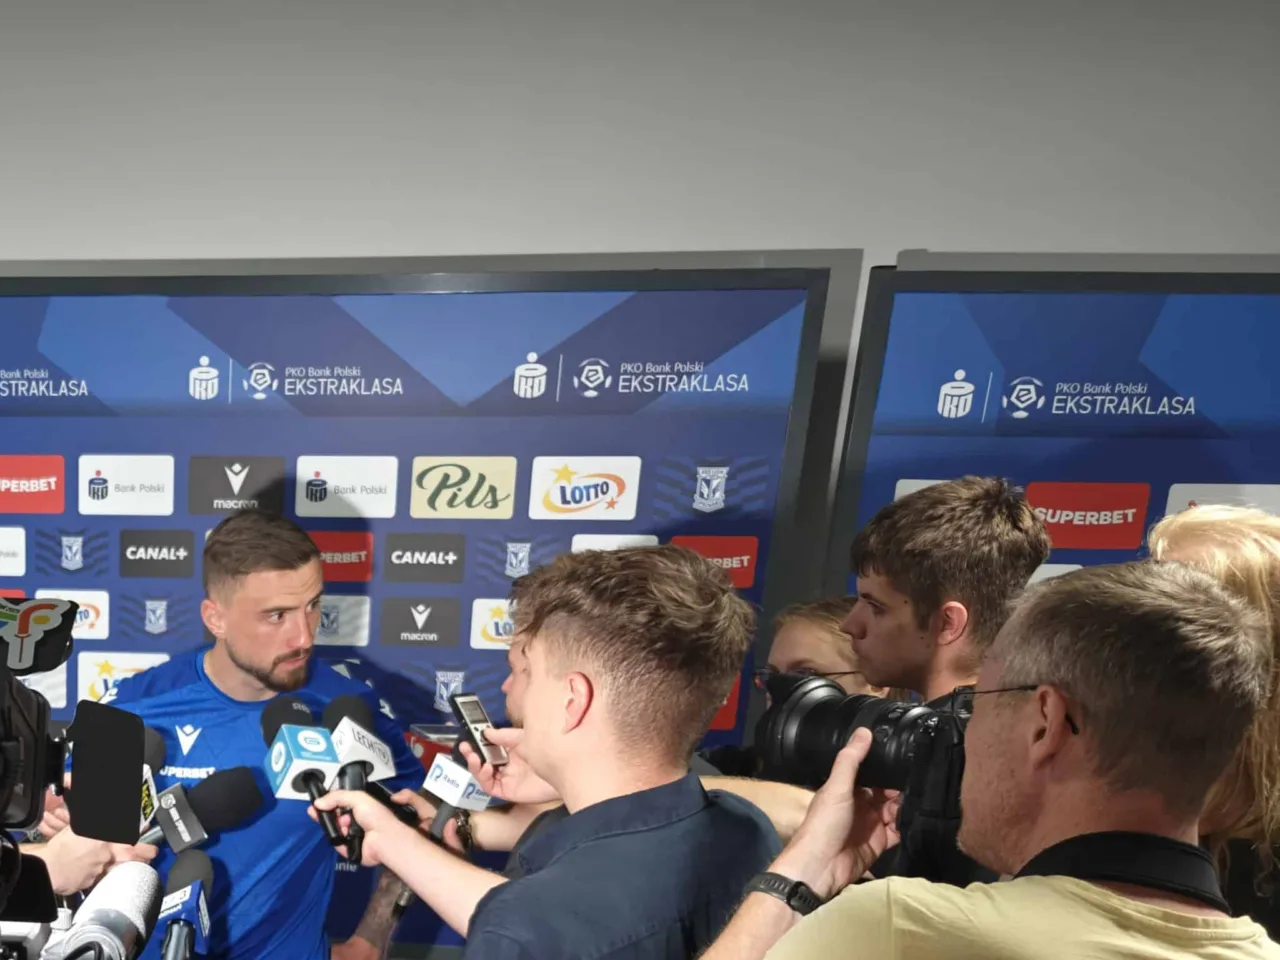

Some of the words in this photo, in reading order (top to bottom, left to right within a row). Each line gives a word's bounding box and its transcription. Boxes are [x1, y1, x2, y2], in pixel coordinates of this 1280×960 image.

[285, 367, 305, 377] PKO
[308, 367, 331, 377] Bank
[334, 366, 361, 376] Polski
[620, 363, 642, 373] PKO
[645, 362, 671, 372] Bank
[674, 362, 704, 372] Polski
[0, 369, 21, 379] Bank
[24, 369, 48, 379] Polski
[284, 378, 403, 395] EKSTRAKLASA
[618, 374, 749, 393] EKSTRAKLASA
[1056, 383, 1080, 394] PKO
[1083, 383, 1112, 394] Bank
[1115, 383, 1147, 394] Polski
[1052, 396, 1196, 416] EKSTRAKLASA
[114, 483, 136, 493] Bank
[139, 483, 165, 493] Polski
[333, 485, 356, 495] Bank
[360, 484, 387, 495] Polski
[416, 463, 510, 512] Pils
[560, 480, 609, 505] LOTTO
[213, 498, 258, 509] macron
[1035, 507, 1136, 525] SUPERBET
[126, 547, 188, 560] CANAL+
[320, 551, 367, 563] PERBET
[391, 550, 457, 565] CANAL+
[400, 632, 437, 641] macron
[160, 765, 216, 779] UPERBET
